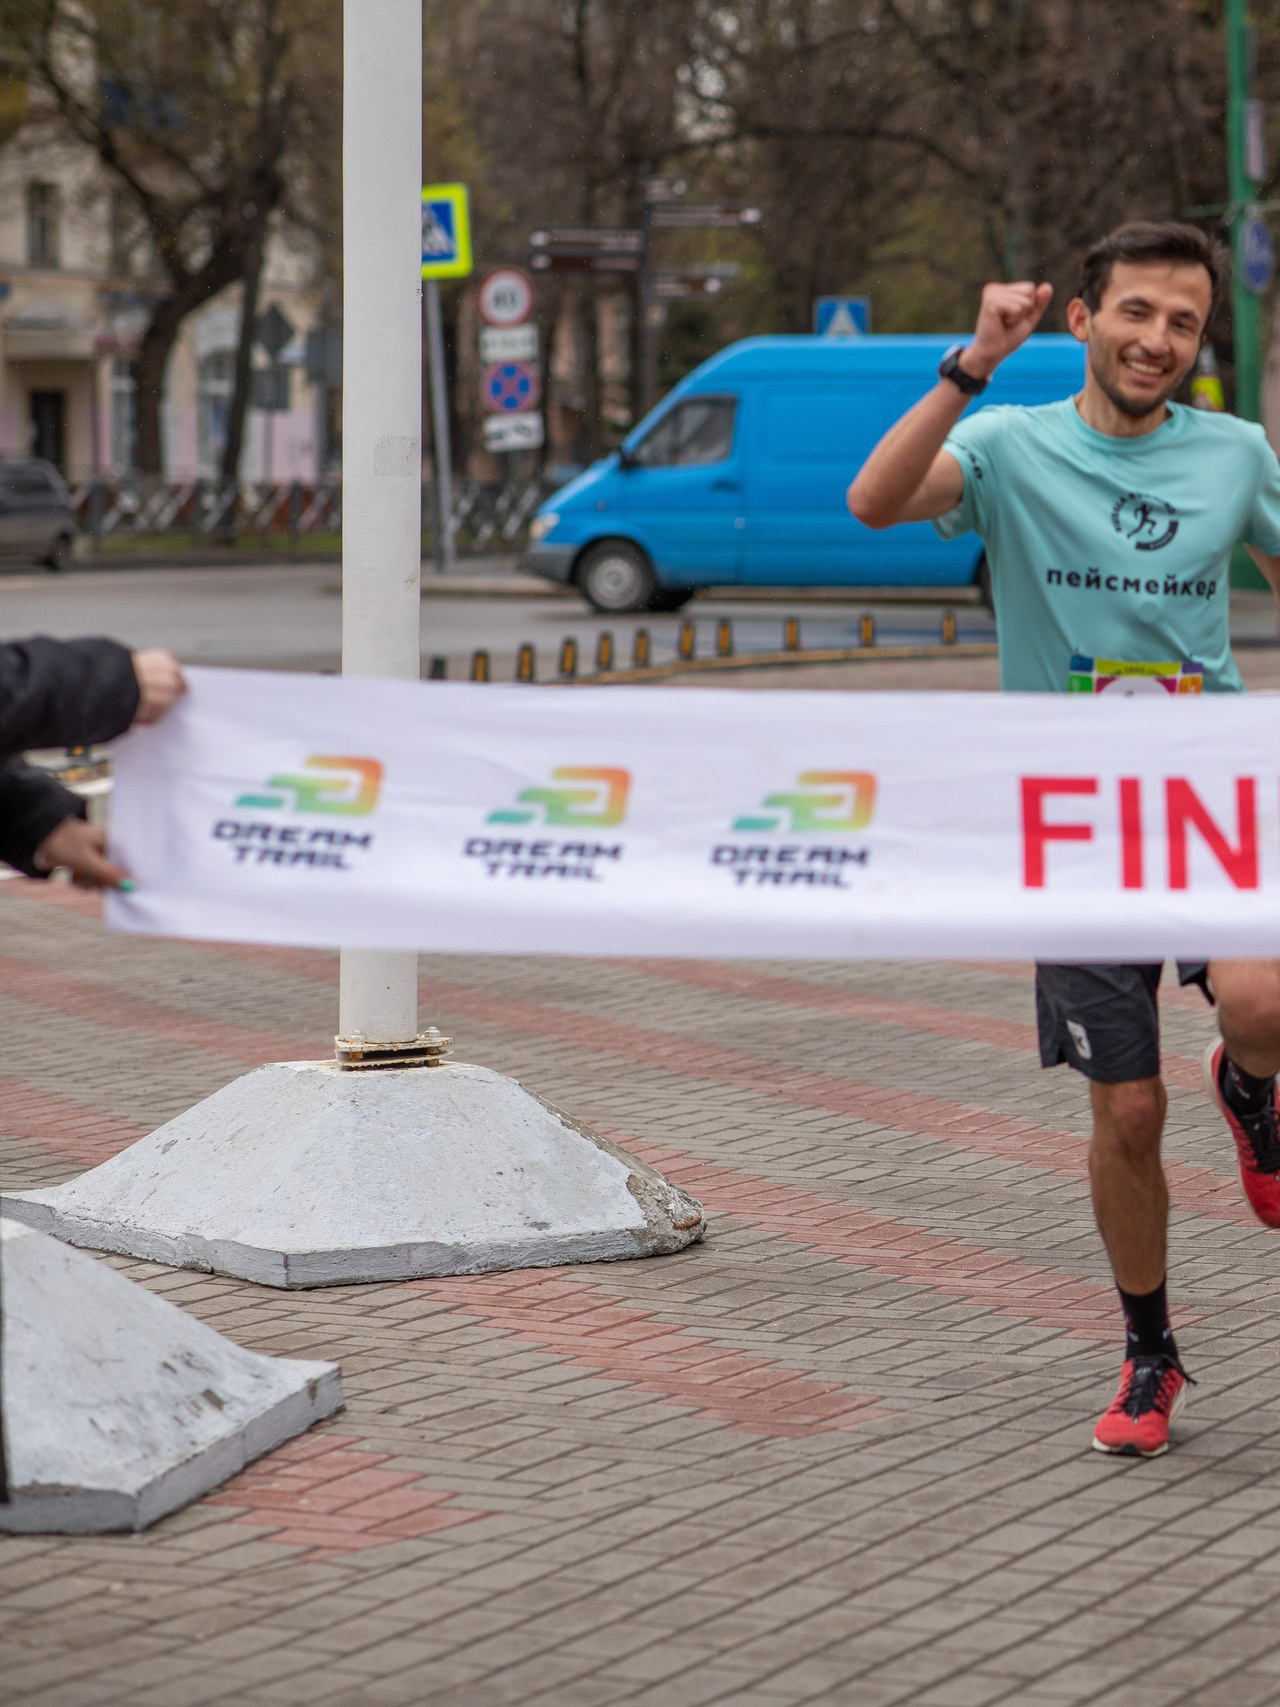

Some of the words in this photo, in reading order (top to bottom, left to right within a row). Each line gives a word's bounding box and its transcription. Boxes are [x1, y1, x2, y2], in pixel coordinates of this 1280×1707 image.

[1046, 567, 1217, 600] пейсмейкер
[210, 819, 374, 849] DREAM
[233, 845, 352, 871] TRAIL
[464, 838, 624, 862] DREAM
[711, 844, 871, 868] DREAM
[486, 861, 604, 883] TRAIL
[733, 868, 852, 890] TRAIL
